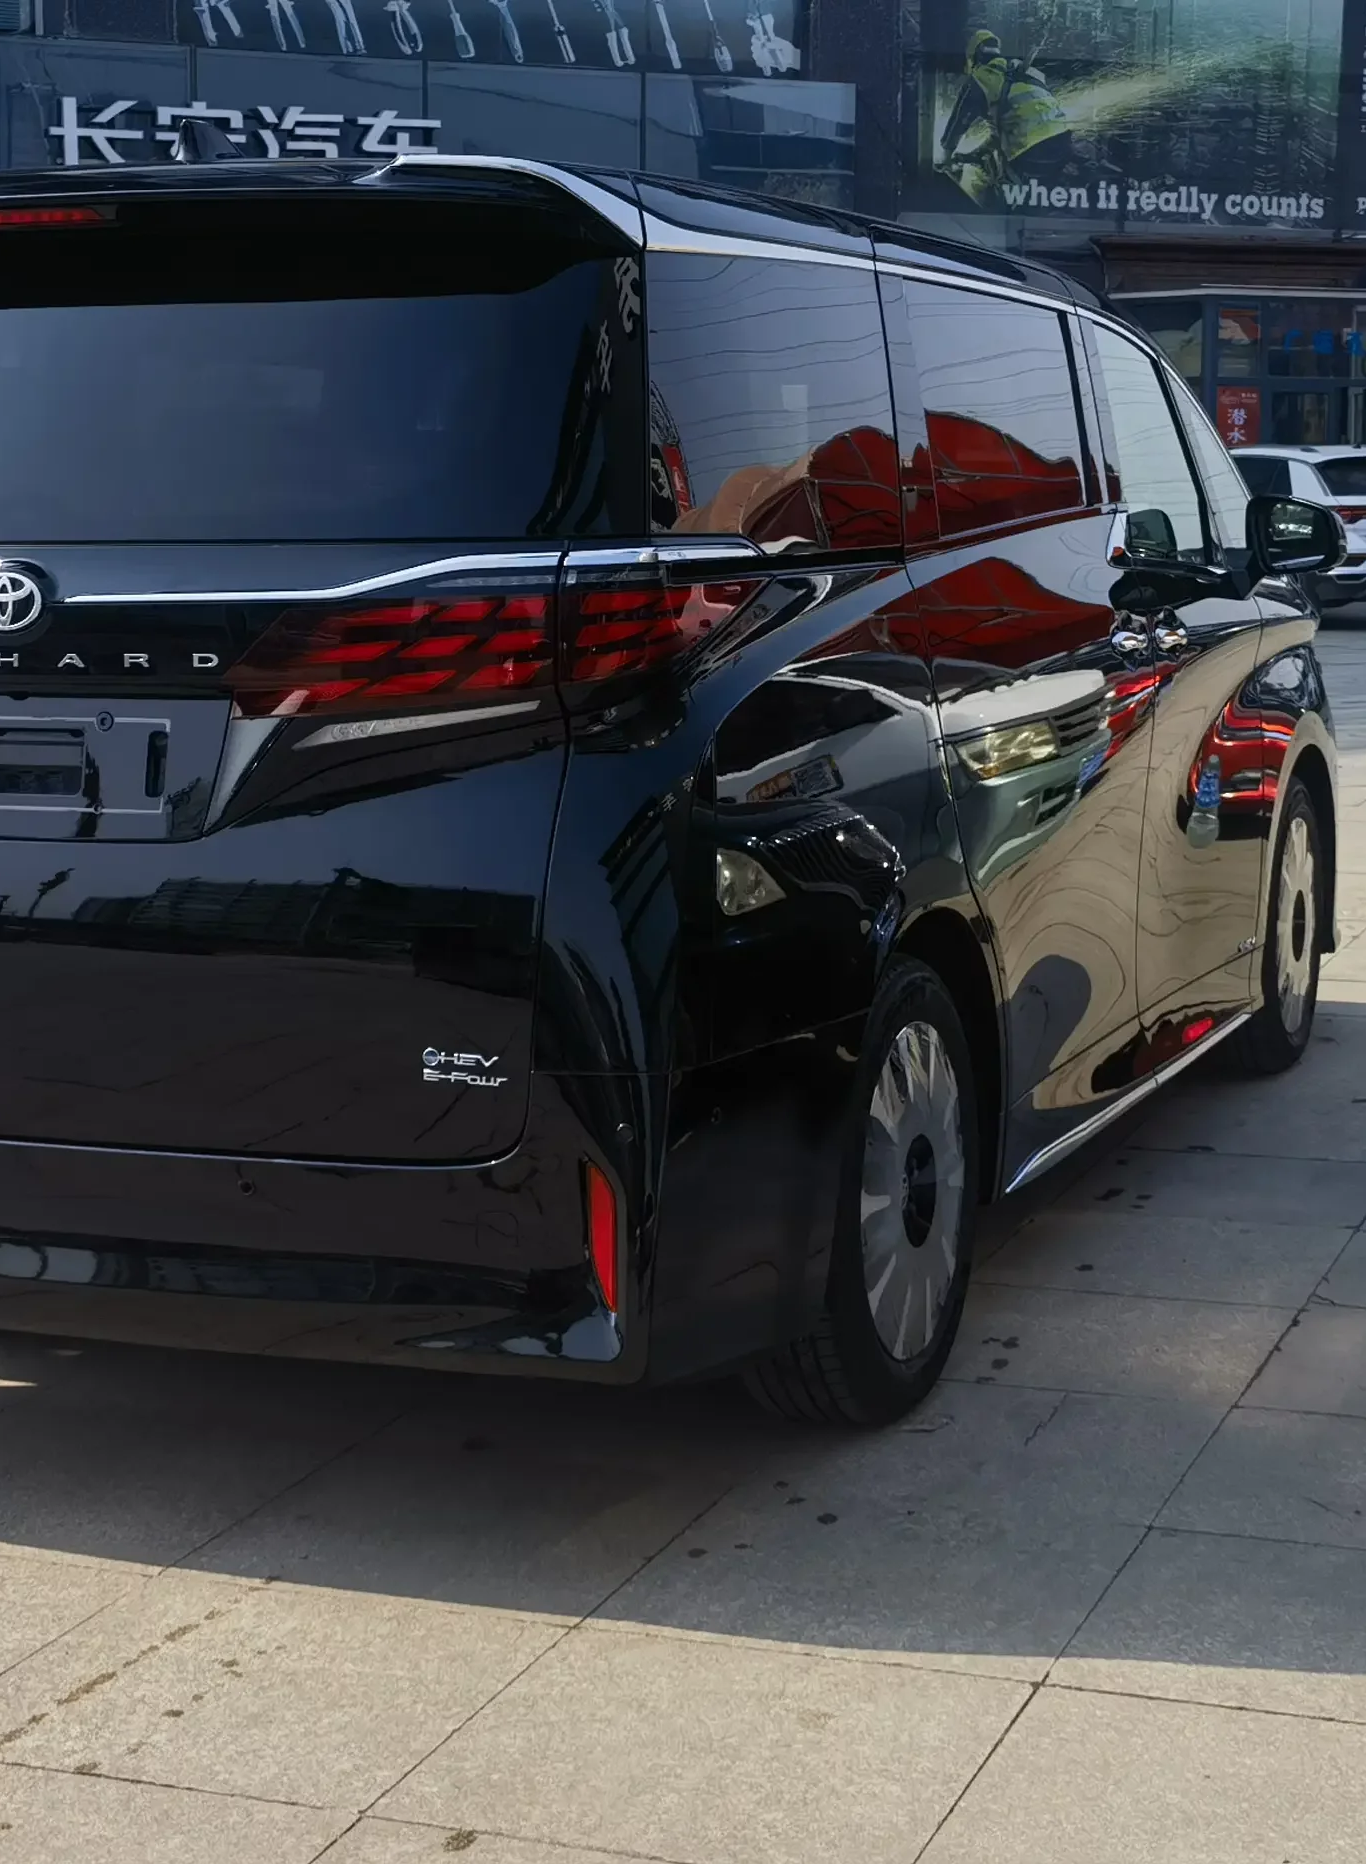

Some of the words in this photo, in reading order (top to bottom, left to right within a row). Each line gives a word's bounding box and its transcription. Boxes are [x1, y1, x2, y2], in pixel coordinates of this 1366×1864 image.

[1002, 179, 1089, 208] when
[1097, 180, 1118, 209] it
[1126, 186, 1218, 219] really
[1224, 193, 1324, 218] counts
